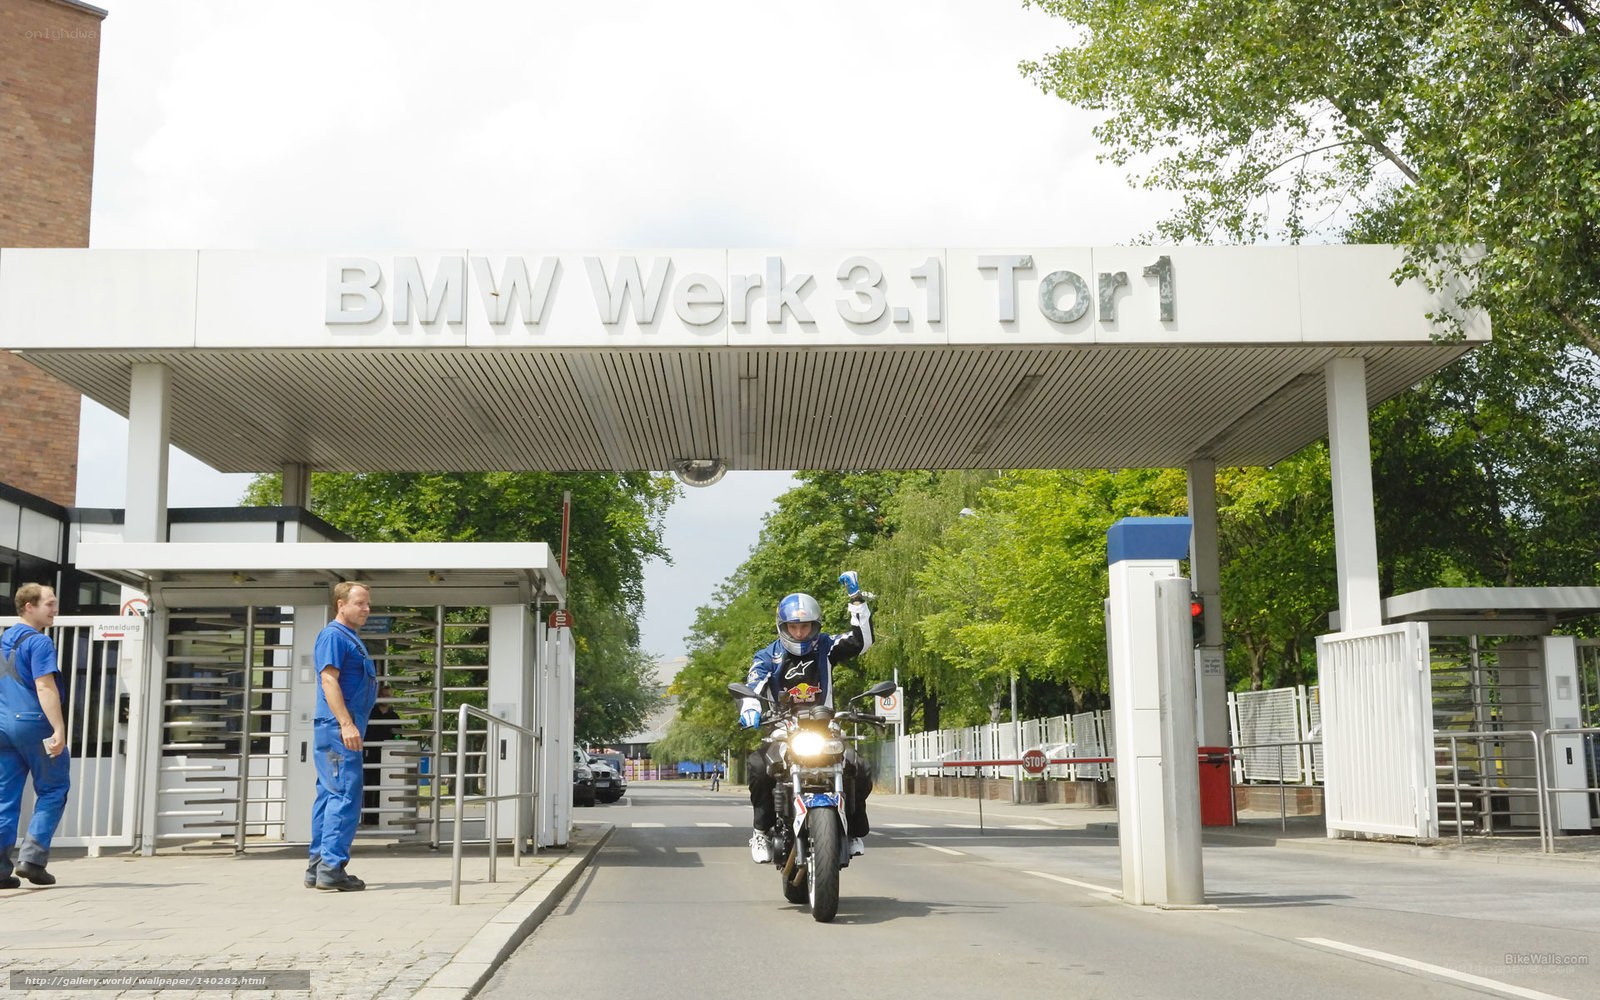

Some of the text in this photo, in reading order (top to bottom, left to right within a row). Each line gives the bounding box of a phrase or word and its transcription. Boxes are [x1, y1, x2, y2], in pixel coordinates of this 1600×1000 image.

[325, 256, 559, 325] BMW
[584, 256, 816, 326] Werk
[836, 255, 940, 324] 3.1
[555, 610, 567, 628] TOP
[98, 624, 140, 632] Anmeldung
[1025, 756, 1046, 767] STOP
